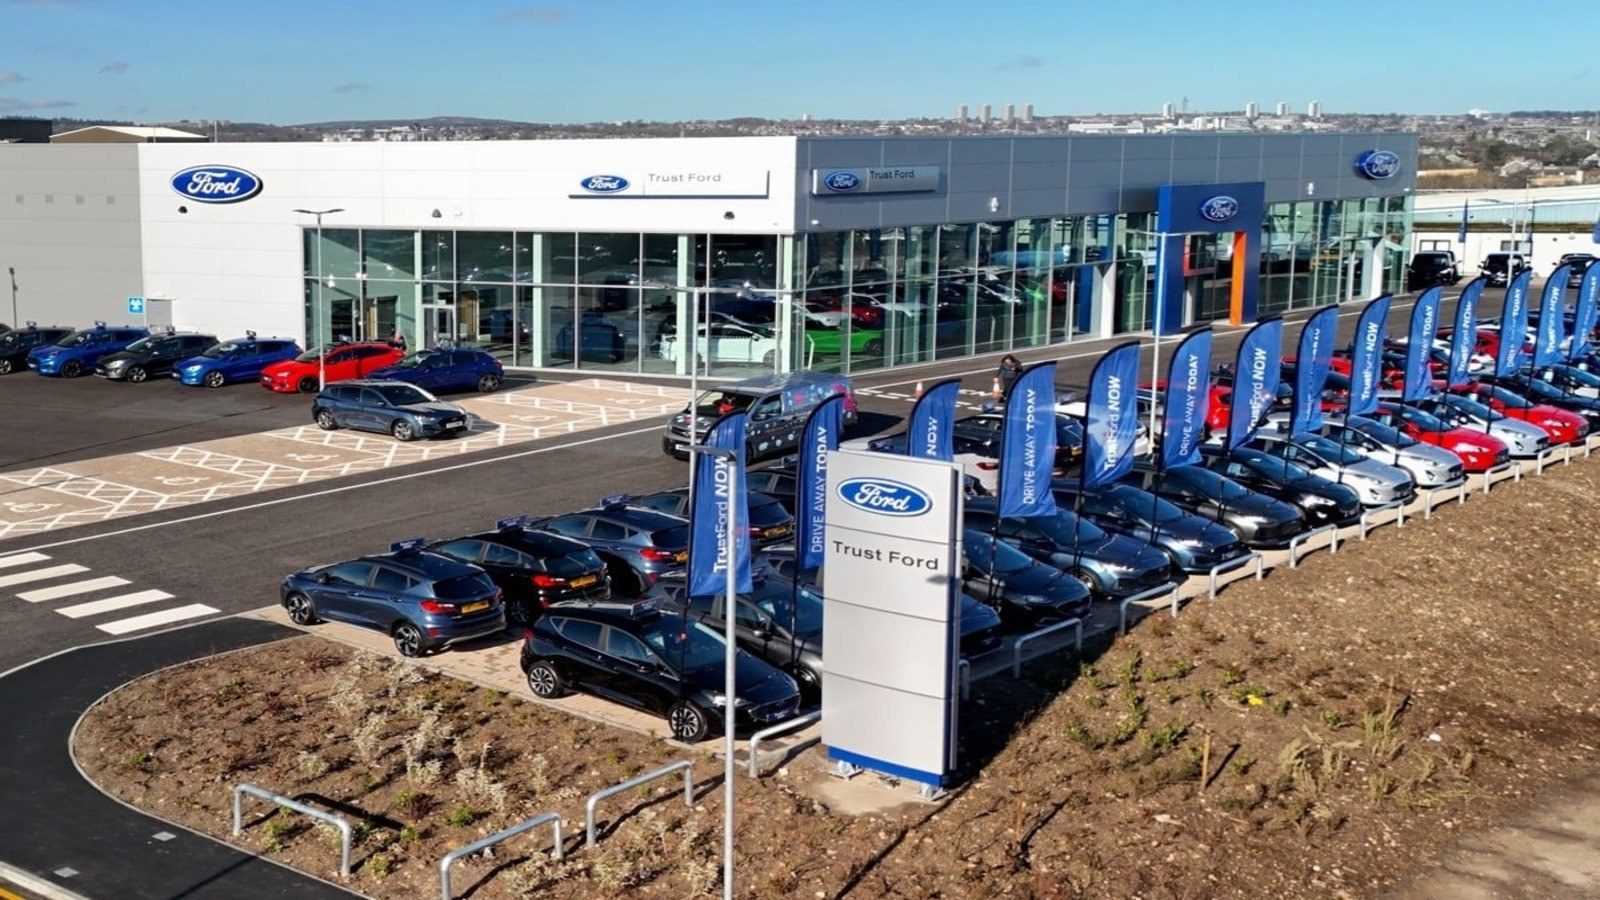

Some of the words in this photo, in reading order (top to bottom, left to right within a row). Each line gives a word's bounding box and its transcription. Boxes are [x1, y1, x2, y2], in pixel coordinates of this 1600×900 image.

[187, 172, 241, 194] Ford
[588, 176, 620, 190] Ford
[648, 173, 684, 182] Trust
[688, 173, 721, 182] Ford
[832, 174, 855, 188] Ford
[870, 171, 893, 179] Trust
[894, 170, 915, 179] Ford
[1366, 322, 1379, 351] NOW
[1423, 305, 1434, 336] TODAY
[1188, 354, 1199, 392] TODAY
[1252, 347, 1267, 380] NOW
[1026, 388, 1036, 431] TODAY
[1107, 375, 1121, 411] NOW
[1184, 395, 1196, 424] AWAY
[816, 427, 828, 472] TODAY
[926, 416, 938, 456] NOW
[1025, 433, 1036, 467] AWAY
[1180, 425, 1193, 456] DRIVE
[714, 456, 728, 496] NOW
[1023, 470, 1035, 505] DRIVE
[814, 477, 826, 512] AWAY
[854, 483, 911, 511] Ford
[714, 501, 728, 574] TrustFord
[811, 516, 824, 553] DRIVE
[832, 540, 883, 561] Trust
[888, 551, 939, 570] Ford
